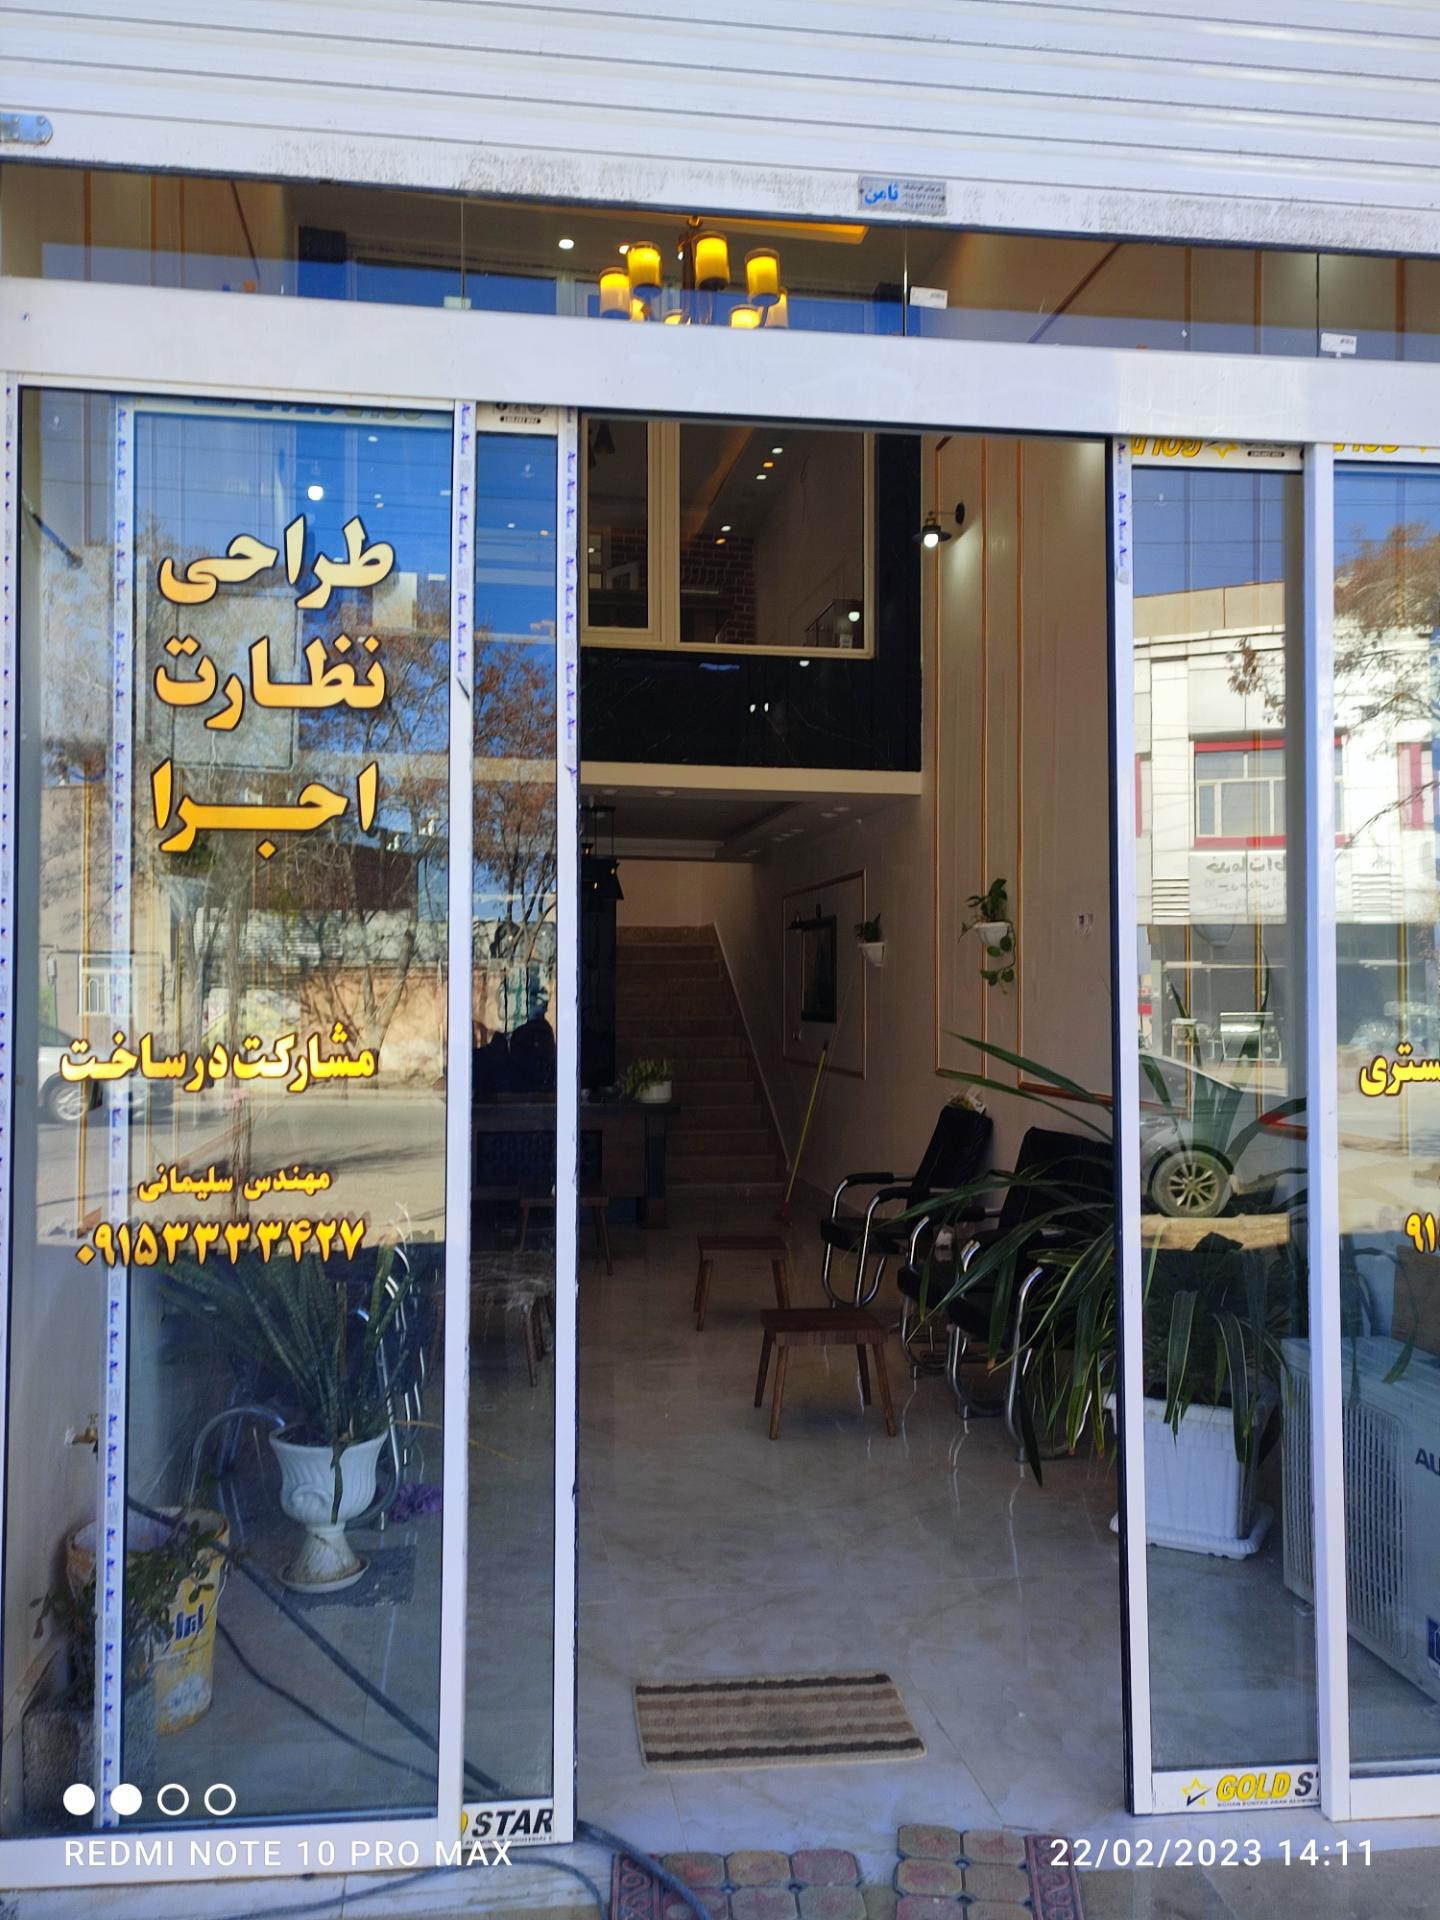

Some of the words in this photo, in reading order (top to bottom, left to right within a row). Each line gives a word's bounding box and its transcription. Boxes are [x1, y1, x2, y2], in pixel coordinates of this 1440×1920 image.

[158, 514, 396, 610] طراحی
[154, 634, 387, 731] نظارت
[151, 759, 380, 859] اجرا
[59, 1031, 187, 1083] ساخت
[185, 1041, 231, 1092] در
[232, 1022, 377, 1092] مشارکت
[138, 1164, 233, 1202] سلیمانی
[243, 1164, 332, 1200] مهندس
[75, 1218, 367, 1268] ۰۹۱۵۳۳۳۳۴۲۷
[1216, 1771, 1292, 1802] GOLD
[1295, 1772, 1319, 1798] S
[472, 1809, 553, 1837] STAR
